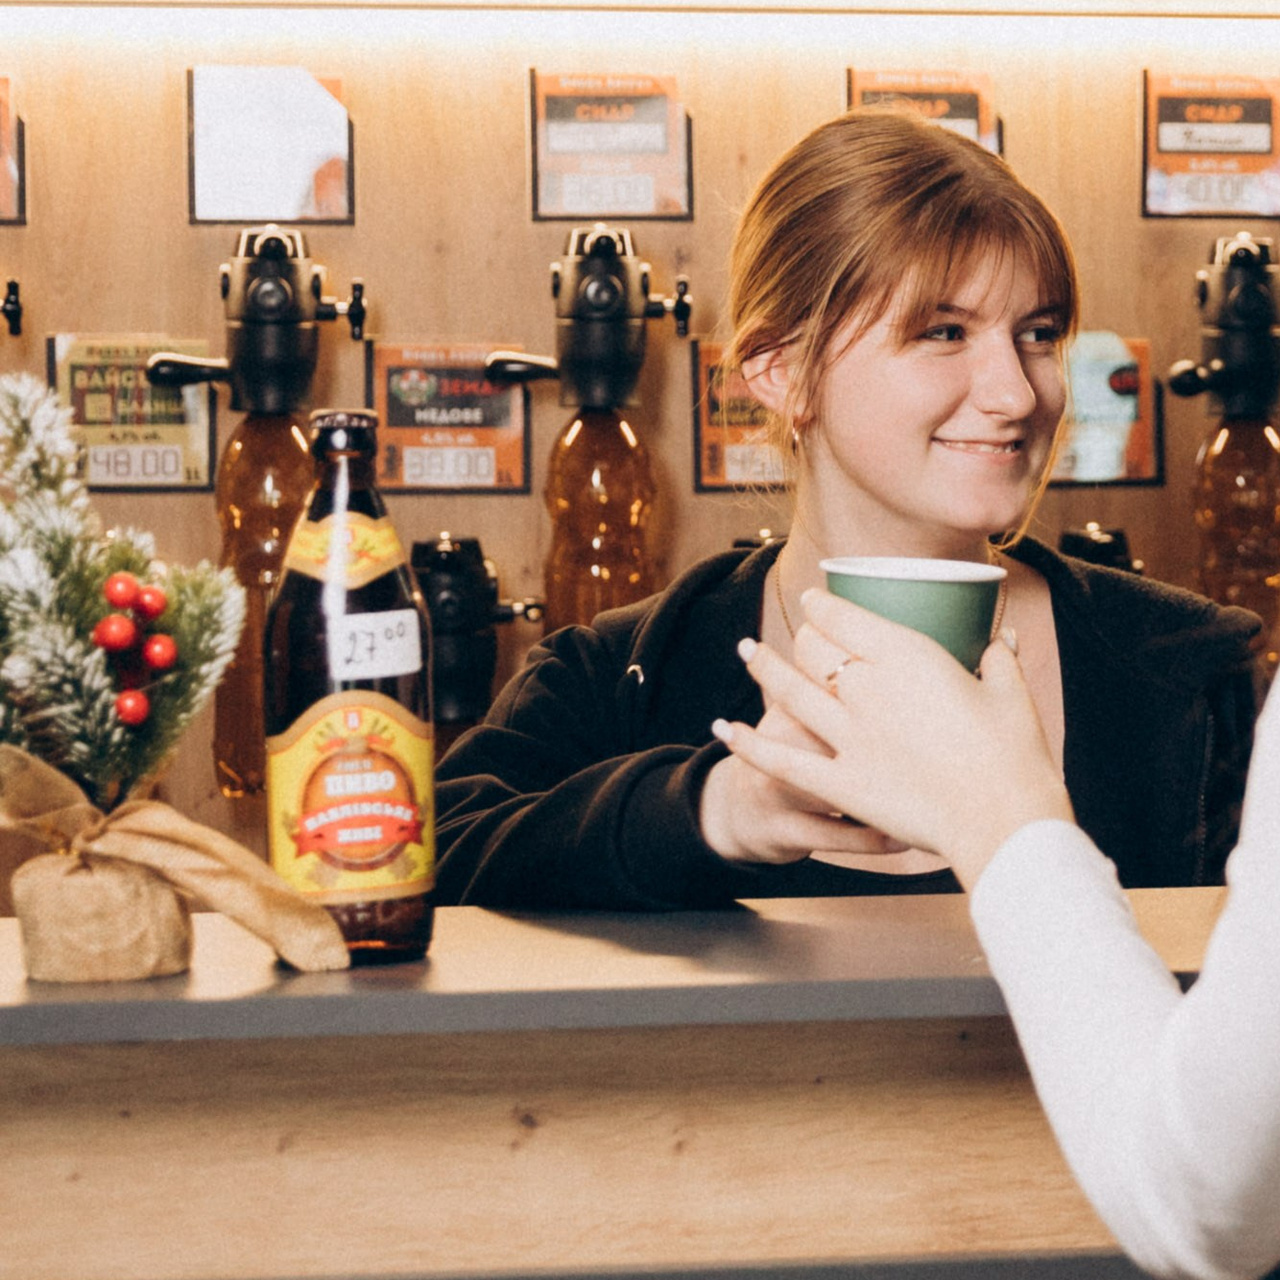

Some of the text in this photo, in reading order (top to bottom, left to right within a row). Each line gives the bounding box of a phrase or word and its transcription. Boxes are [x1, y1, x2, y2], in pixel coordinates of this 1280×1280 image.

[414, 407, 484, 424] МЕДОВЕ
[92, 448, 181, 478] 48.00
[344, 630, 376, 665] 27
[324, 770, 397, 797] ПИВО
